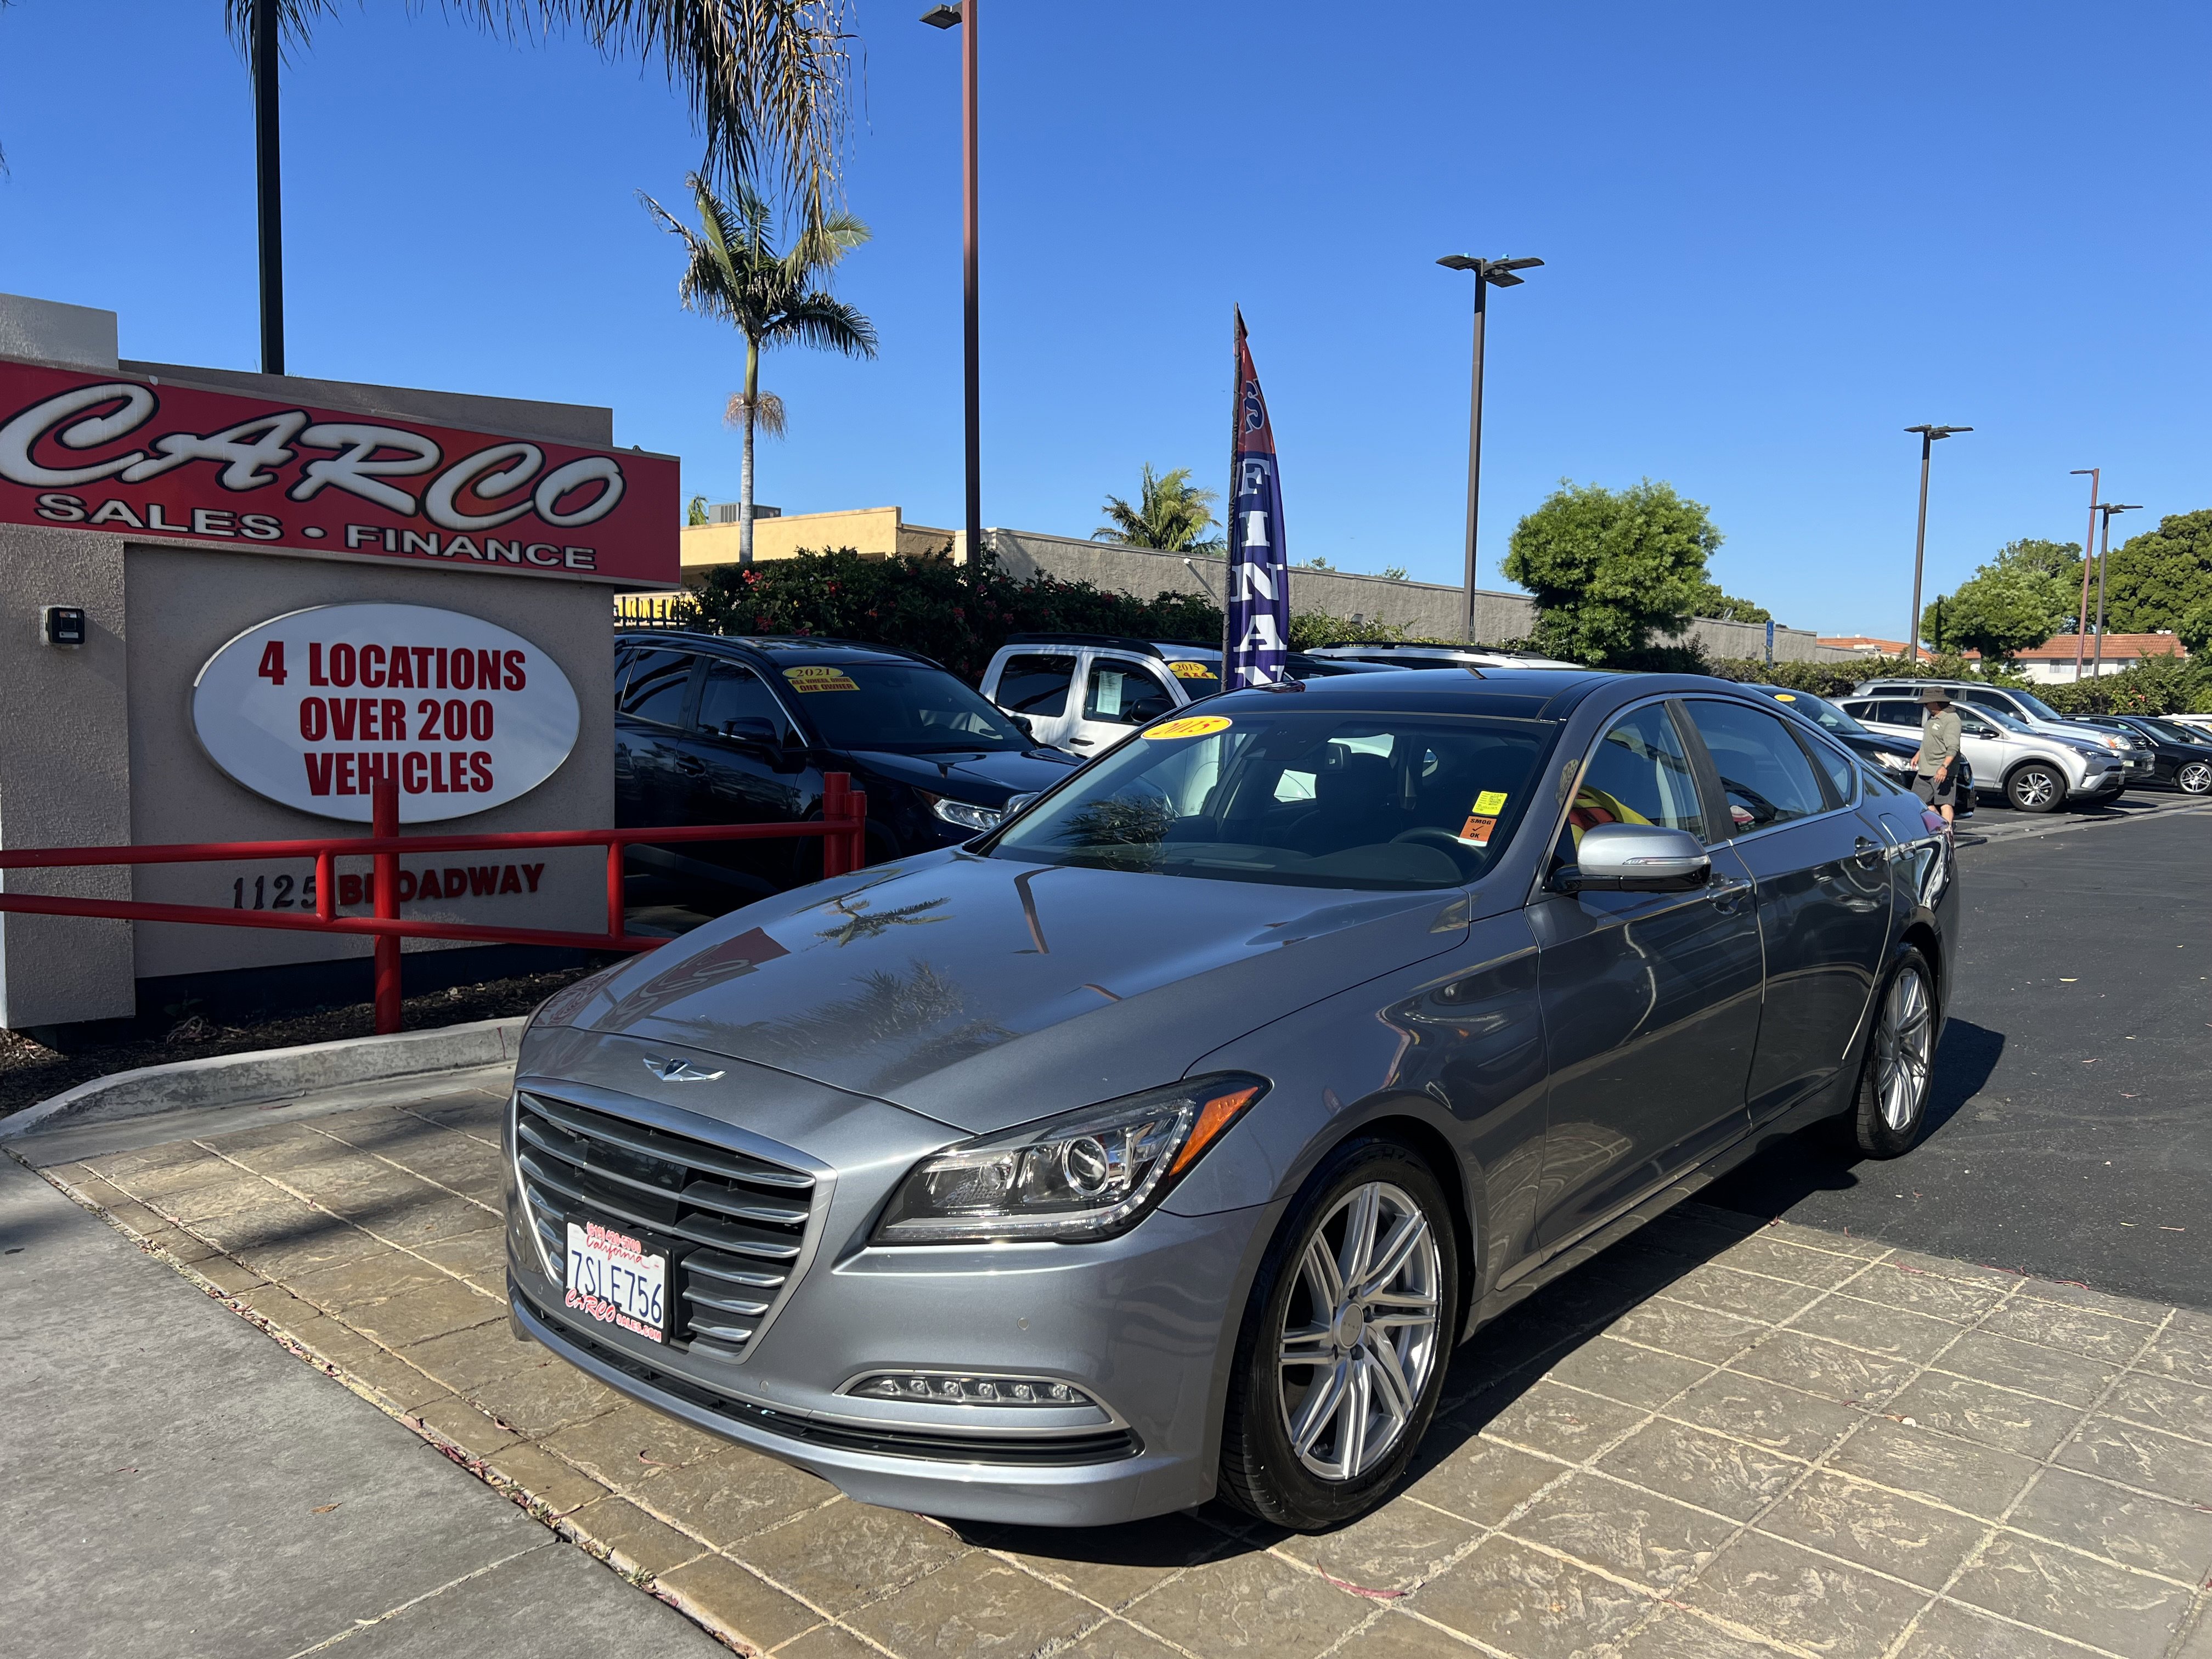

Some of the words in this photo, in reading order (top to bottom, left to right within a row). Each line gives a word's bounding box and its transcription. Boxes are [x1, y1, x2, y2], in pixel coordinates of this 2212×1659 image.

[0, 381, 626, 531] CARCO
[35, 491, 283, 540] SALES
[346, 523, 597, 571] FINANCE
[258, 640, 287, 686] 4
[308, 642, 527, 691] LOCATIONS
[795, 668, 831, 677] 2021
[1175, 663, 1200, 672] 2015
[299, 697, 407, 742] OVER
[417, 698, 494, 741] 200
[303, 751, 494, 796] VEHICLES
[234, 874, 317, 910] 1125
[586, 1221, 605, 1241] (619)
[586, 1235, 650, 1269] California
[571, 1250, 662, 1323] 7SLE756
[565, 1288, 616, 1323] CARCO
[616, 1313, 662, 1343] SALES.COM
